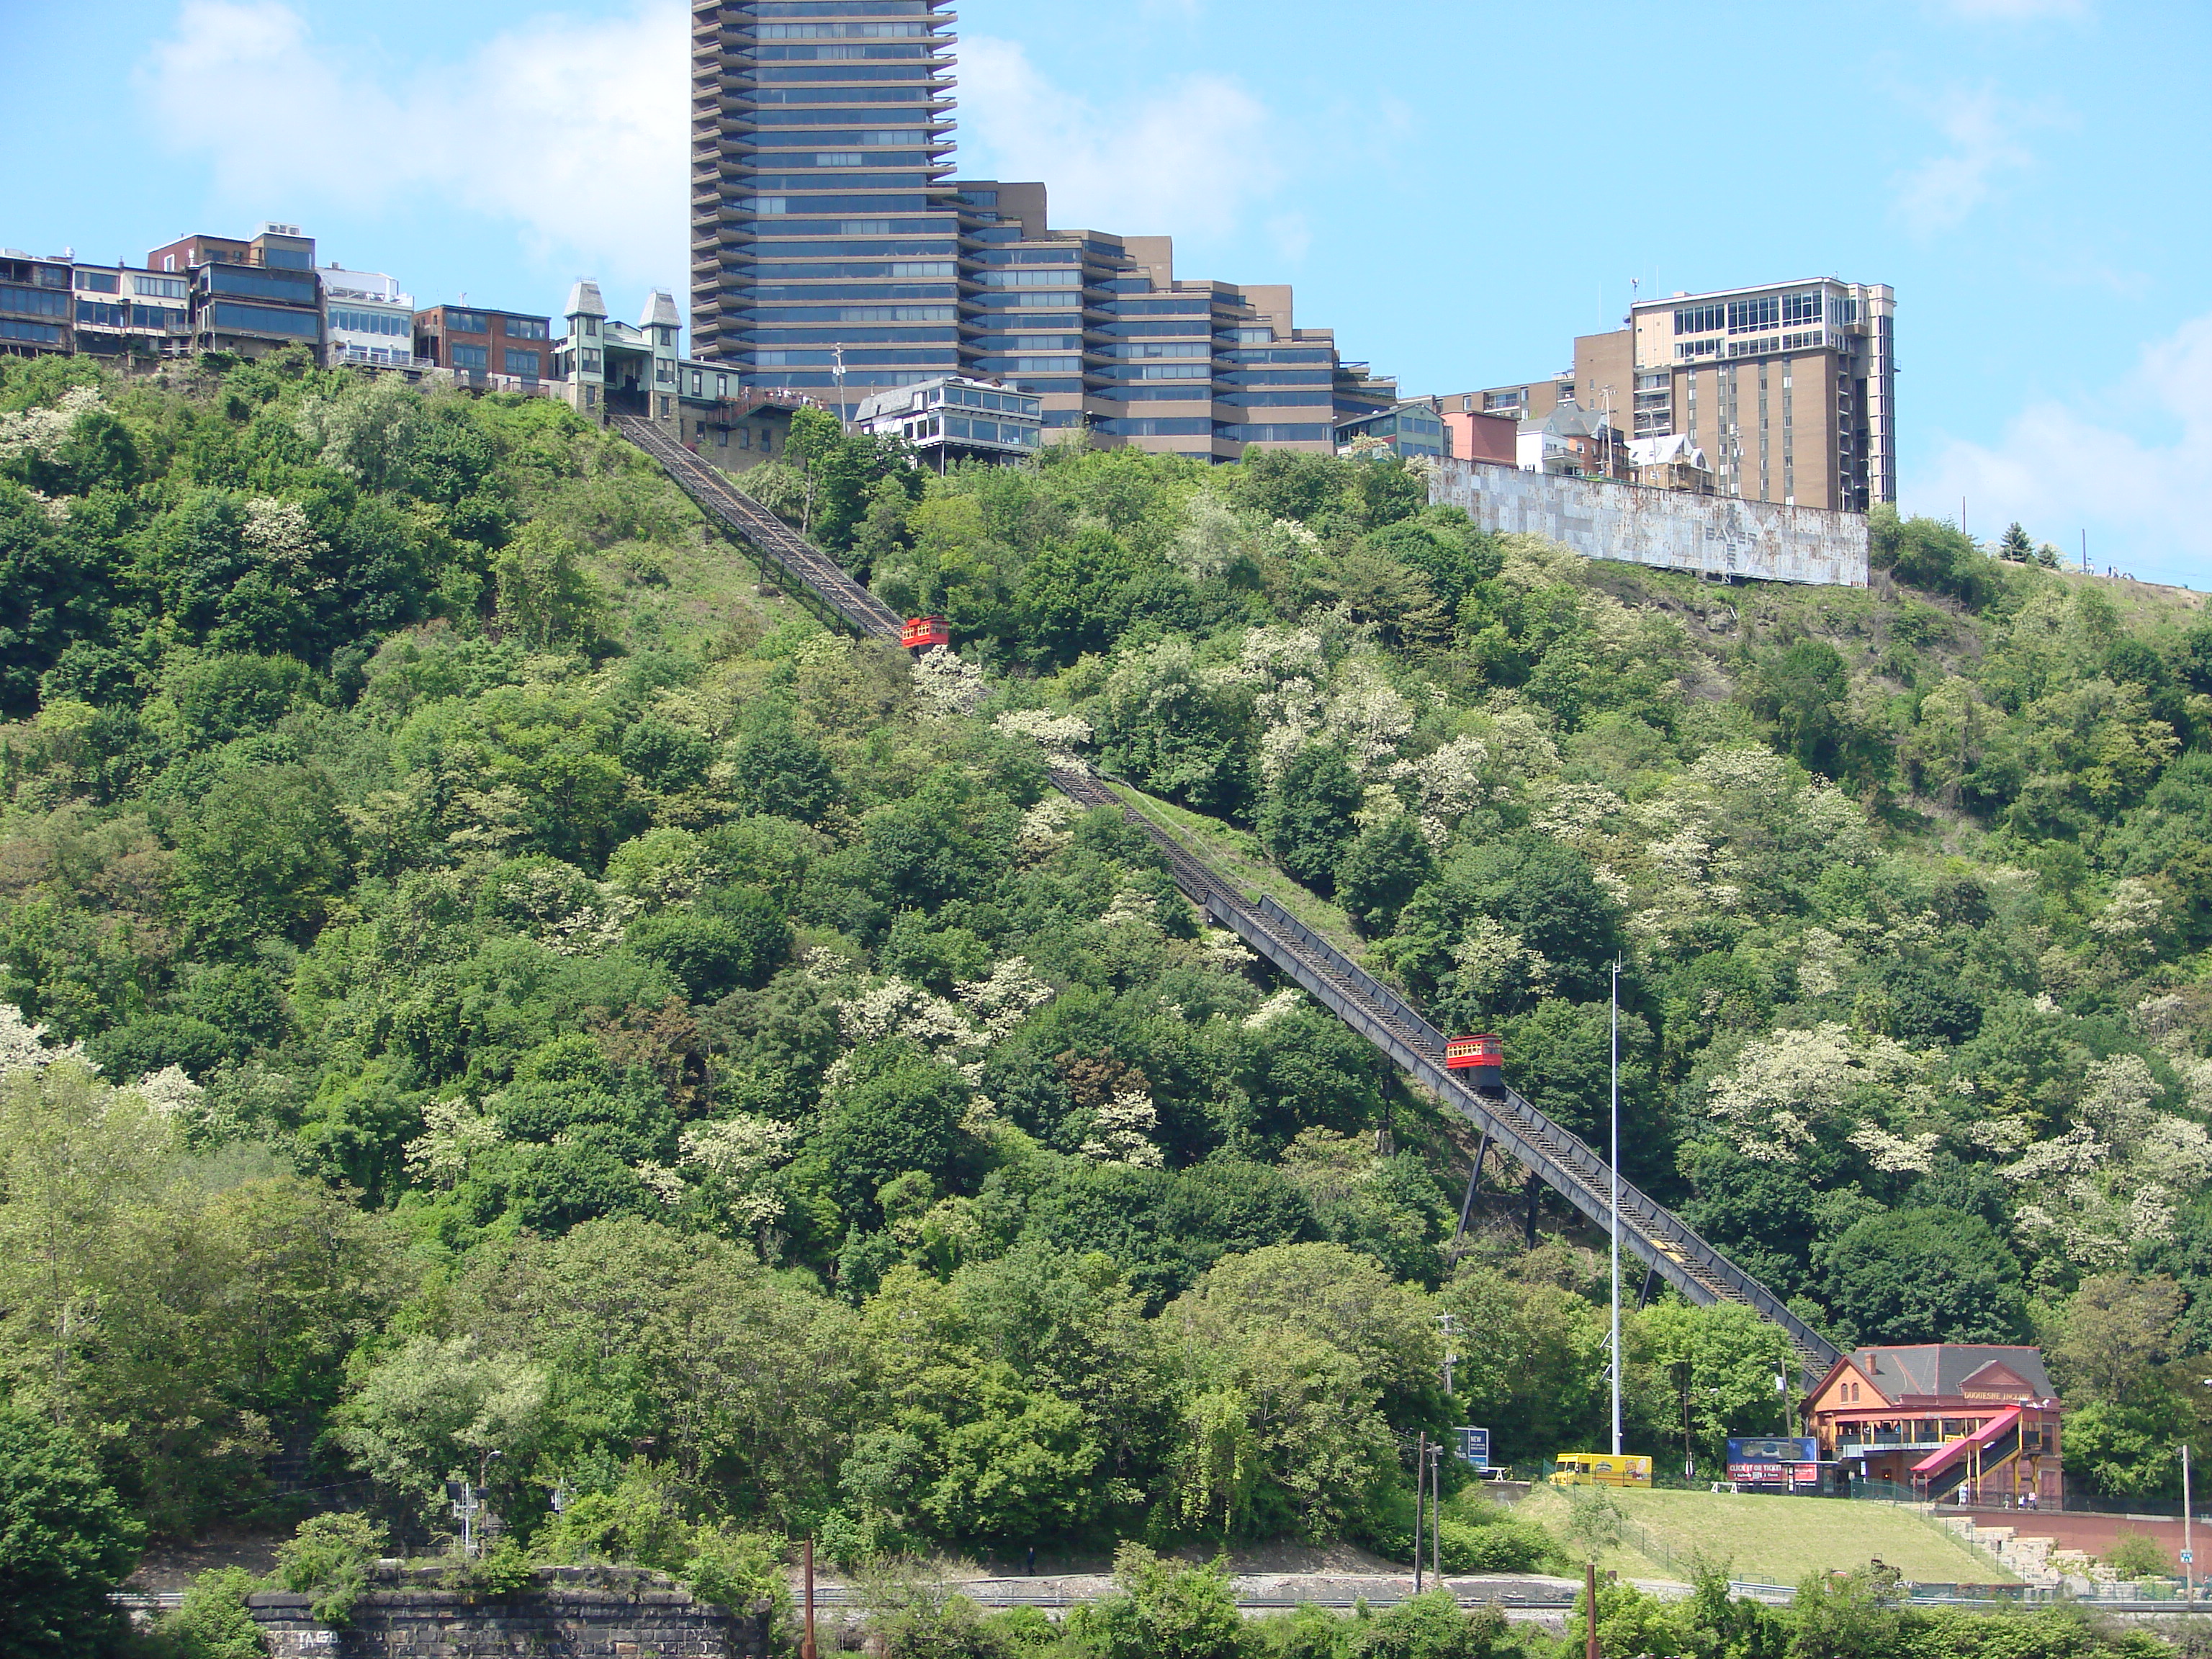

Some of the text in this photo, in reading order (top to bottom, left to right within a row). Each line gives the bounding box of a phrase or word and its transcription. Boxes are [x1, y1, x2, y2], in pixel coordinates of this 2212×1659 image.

[1706, 527, 1758, 545] BAYER
[1726, 503, 1736, 570] BAYER
[1964, 1391, 2031, 1401] DUQUESNE INCLINE
